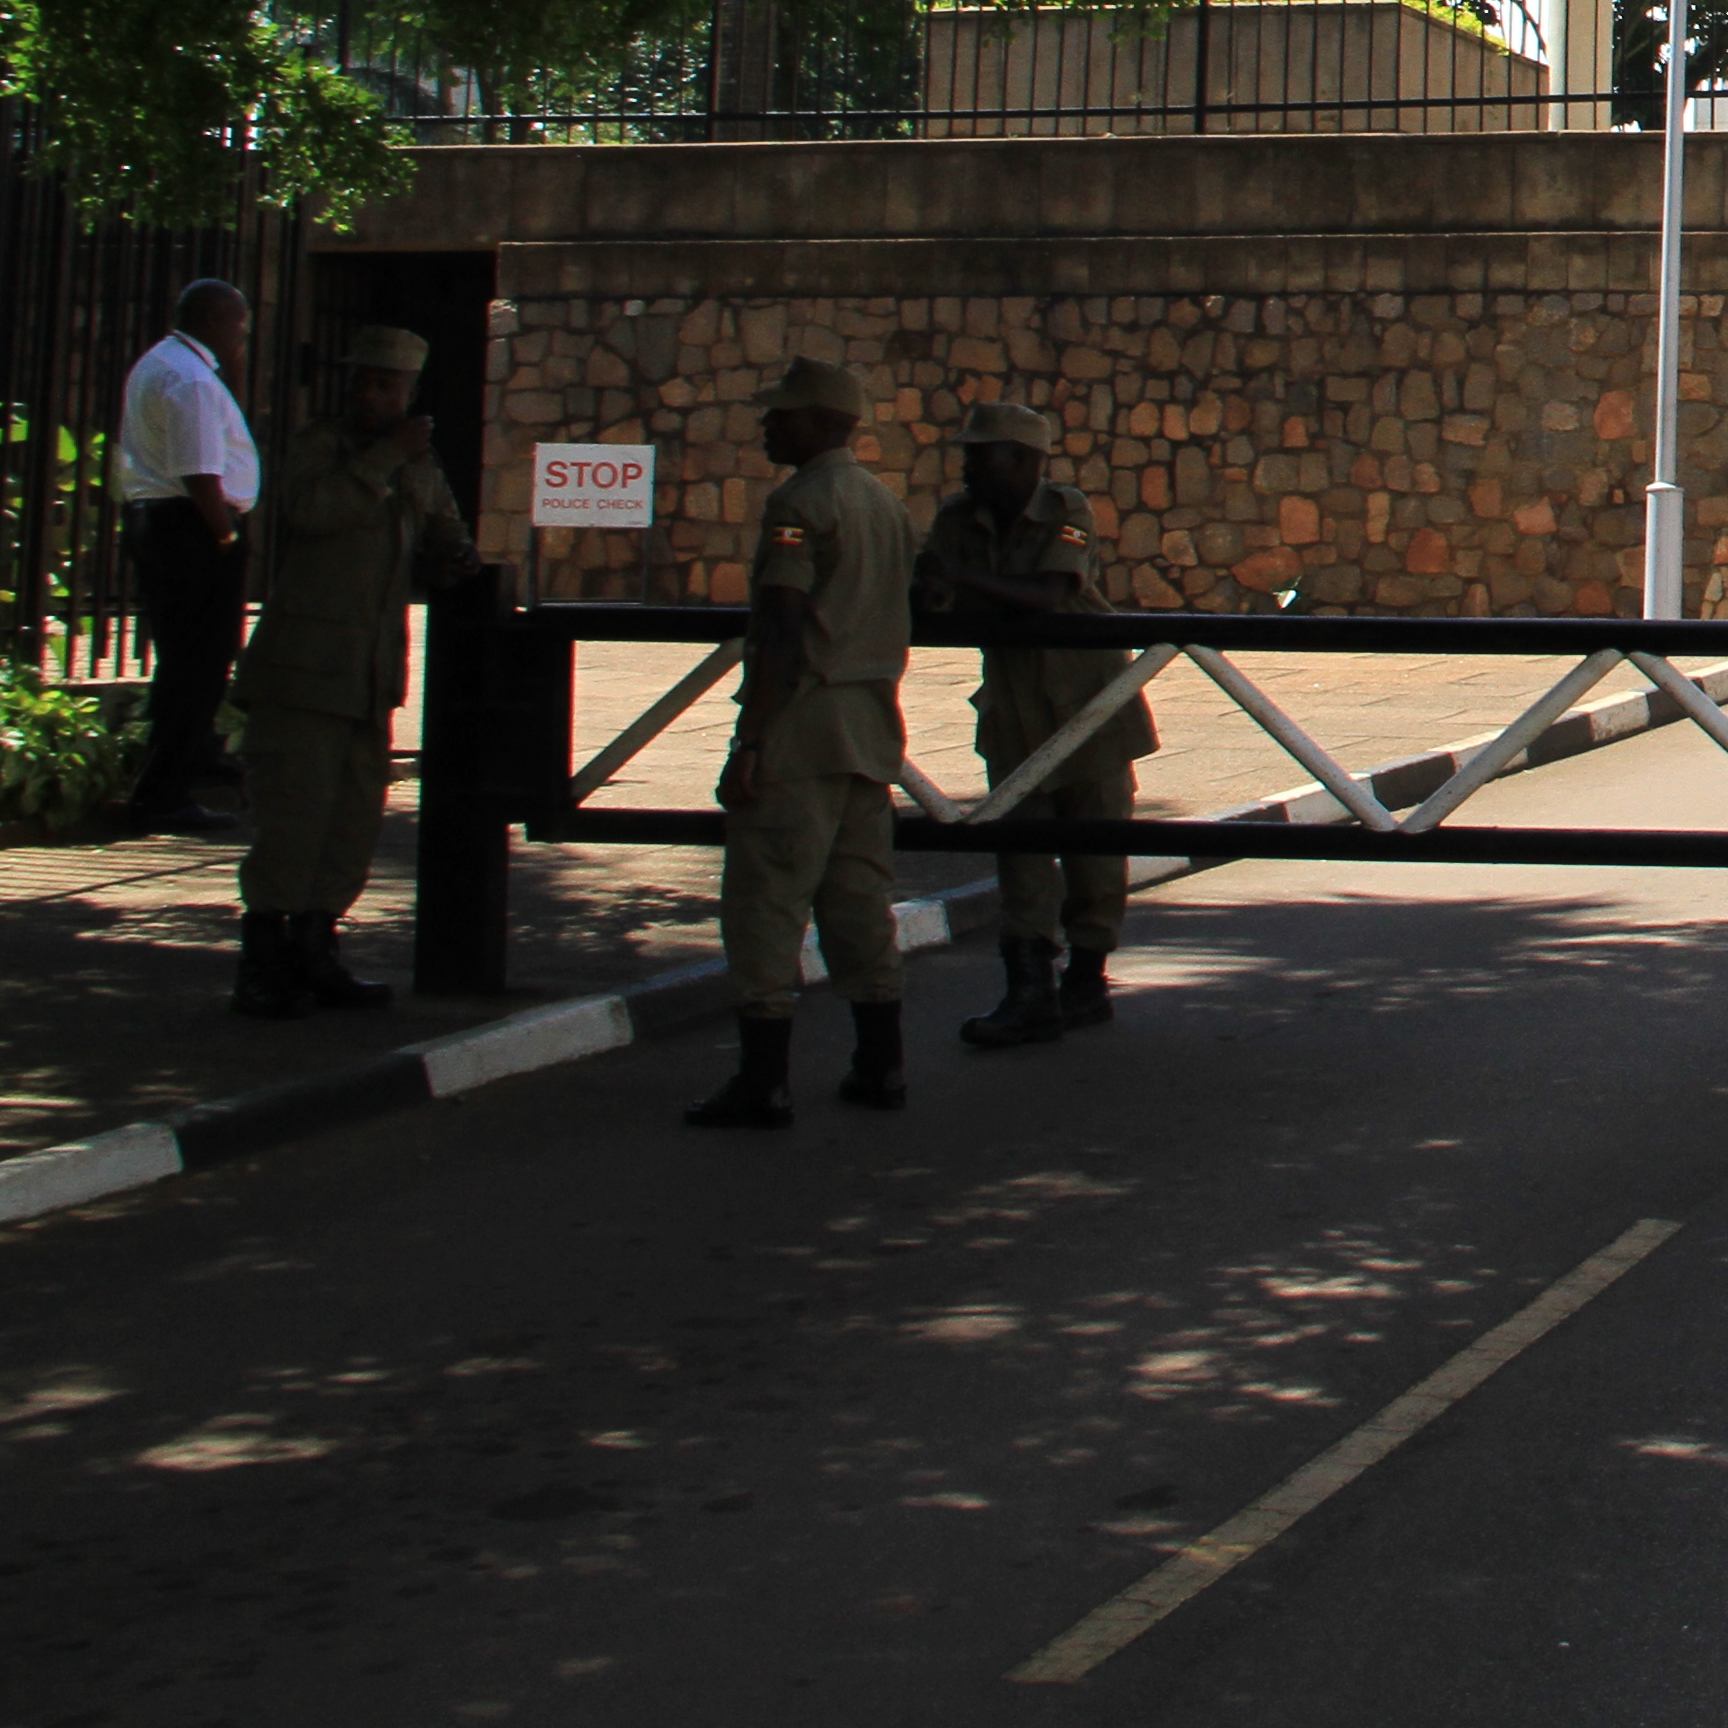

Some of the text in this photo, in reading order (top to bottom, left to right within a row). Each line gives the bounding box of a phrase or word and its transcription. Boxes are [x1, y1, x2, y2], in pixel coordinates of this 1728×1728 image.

[545, 460, 644, 489] STOP
[542, 498, 644, 510] POLICE CHECK
